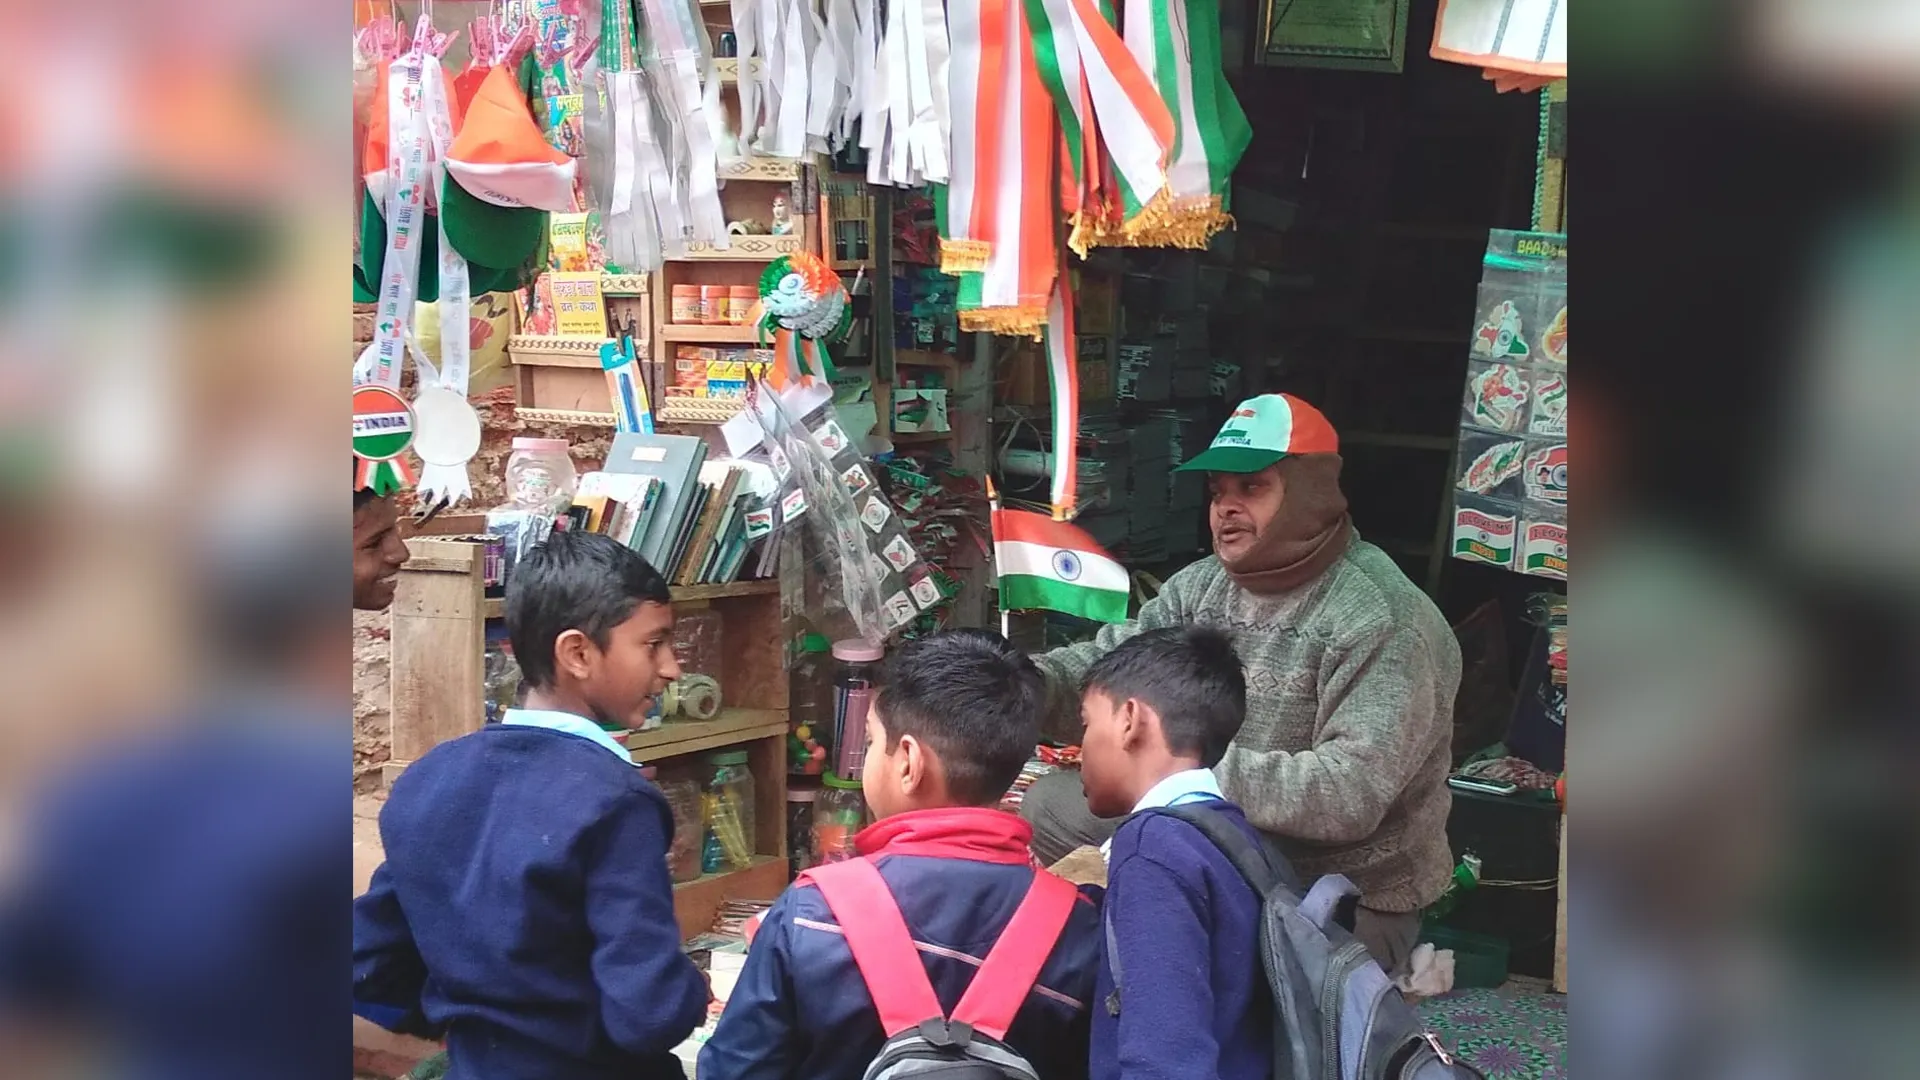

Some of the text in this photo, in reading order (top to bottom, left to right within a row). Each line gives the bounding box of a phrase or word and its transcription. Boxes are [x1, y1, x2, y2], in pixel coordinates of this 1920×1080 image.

[578, 301, 597, 312] कथा
[364, 416, 408, 430] INDIA
[1468, 516, 1492, 528] LOVE
[1533, 528, 1538, 538] I
[1471, 542, 1497, 560] INDIA
